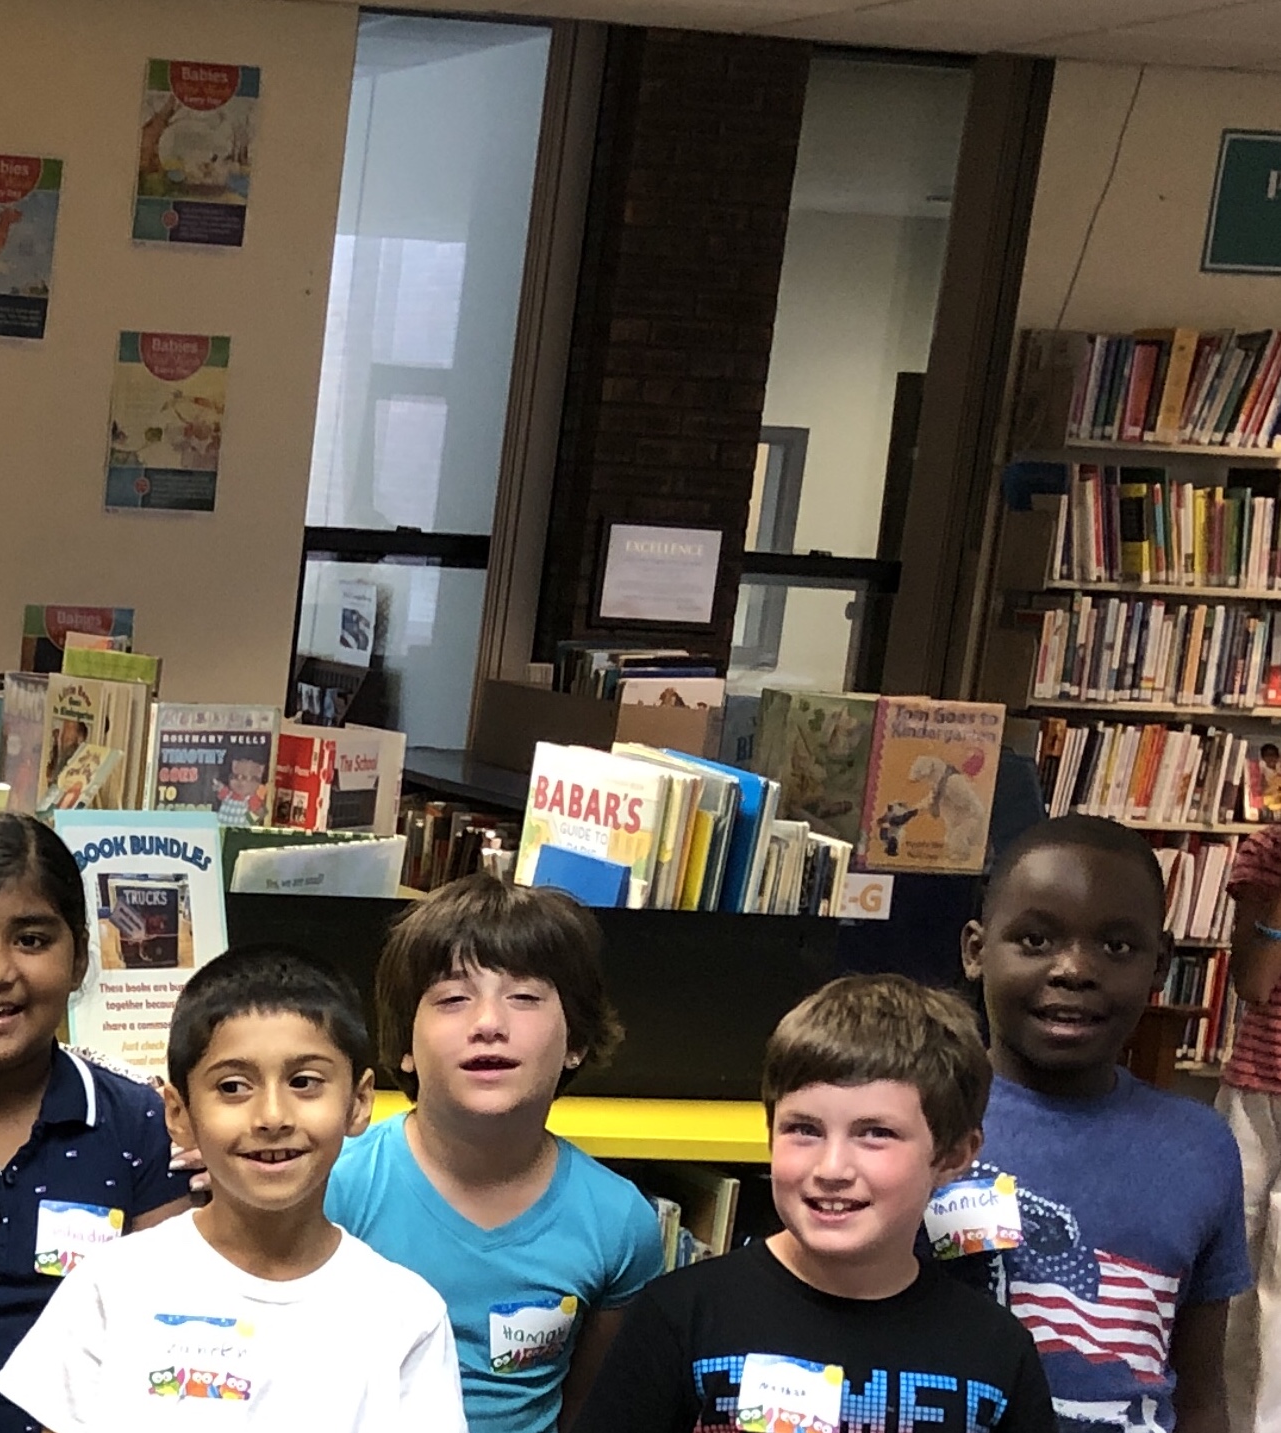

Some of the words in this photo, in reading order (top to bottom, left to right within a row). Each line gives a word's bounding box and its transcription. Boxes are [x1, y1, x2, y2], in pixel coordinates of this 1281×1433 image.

[181, 66, 229, 83] Babies
[626, 540, 704, 556] EXCELLENCE
[895, 705, 929, 722] Tom
[933, 707, 976, 725] Goes
[981, 710, 999, 726] to
[162, 734, 224, 745] ROSEMARY
[230, 735, 267, 745] WELLS
[891, 721, 997, 744] Kindergarten
[161, 748, 227, 764] TIMOTHY
[340, 754, 353, 772] The
[353, 752, 379, 772] School
[158, 767, 199, 784] GOES
[158, 785, 178, 801] TO
[533, 774, 644, 835] BABAR'S
[560, 822, 591, 842] GUIDE
[595, 830, 609, 846] TO
[73, 835, 128, 874] BOOK
[129, 834, 212, 872] BUNDLES
[122, 889, 168, 906] TRUCKS
[843, 883, 883, 913] -G
[99, 983, 125, 994] These
[126, 983, 152, 994] books
[153, 984, 168, 993] are
[106, 1001, 144, 1012] together
[102, 1021, 128, 1032] share
[129, 1022, 136, 1031] a
[141, 1040, 166, 1051] check
